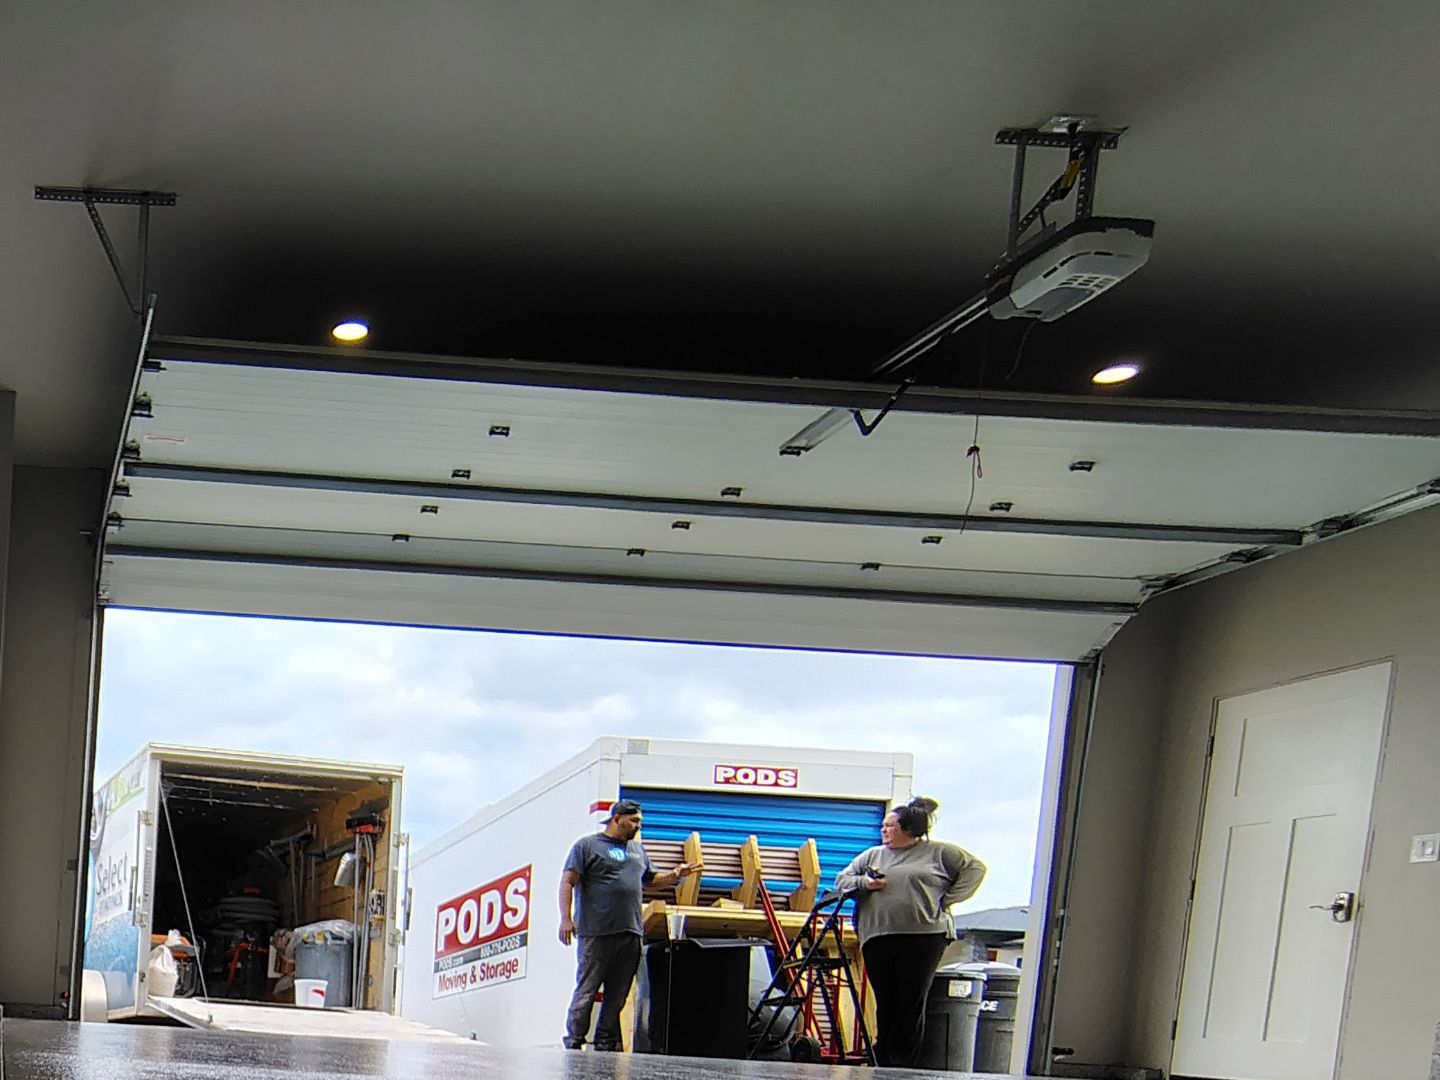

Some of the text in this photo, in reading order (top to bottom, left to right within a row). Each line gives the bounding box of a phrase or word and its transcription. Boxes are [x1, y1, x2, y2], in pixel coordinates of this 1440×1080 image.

[716, 766, 796, 786] PODS
[96, 851, 128, 896] Select
[436, 876, 527, 953] PODS
[438, 957, 519, 992] Moving & Storage
